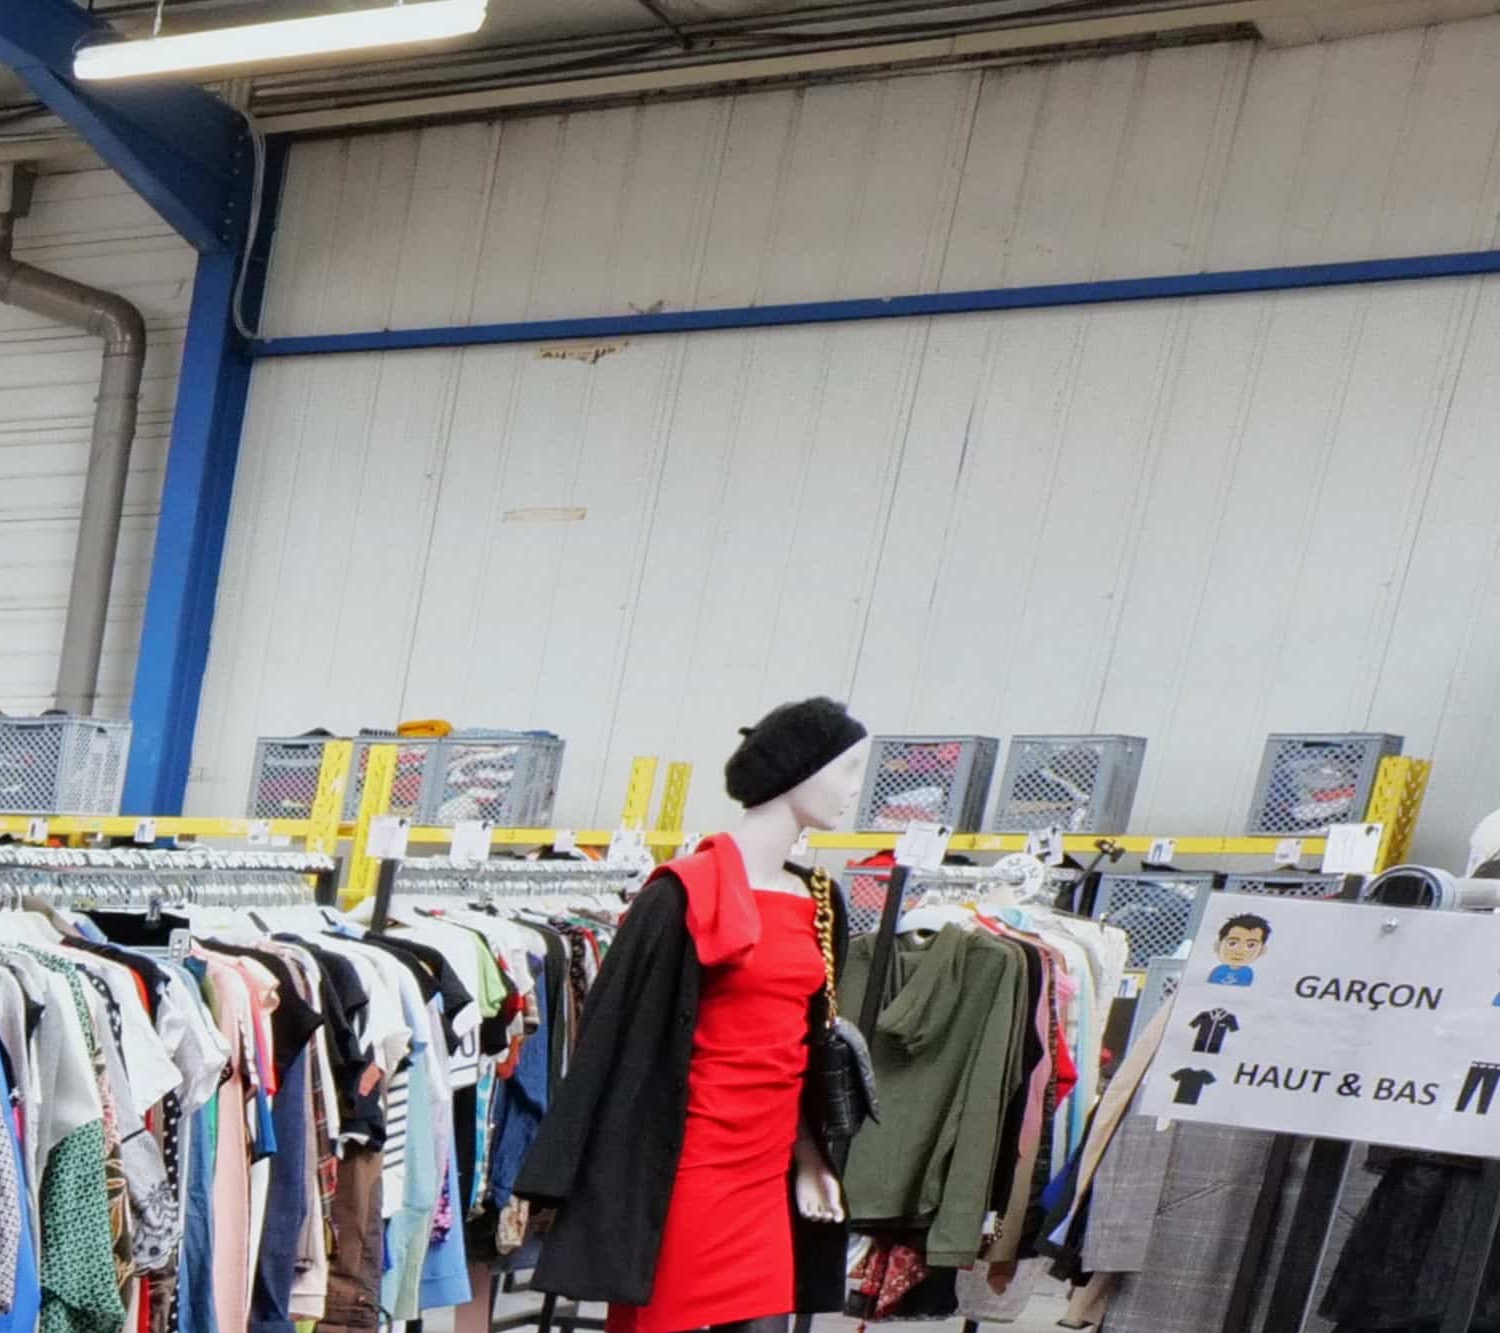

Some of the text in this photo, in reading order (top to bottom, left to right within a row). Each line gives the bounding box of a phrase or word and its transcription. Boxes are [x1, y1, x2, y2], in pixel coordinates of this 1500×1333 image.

[1294, 975, 1444, 1011] GARÇON
[1233, 1062, 1439, 1106] HAUT & BAS
